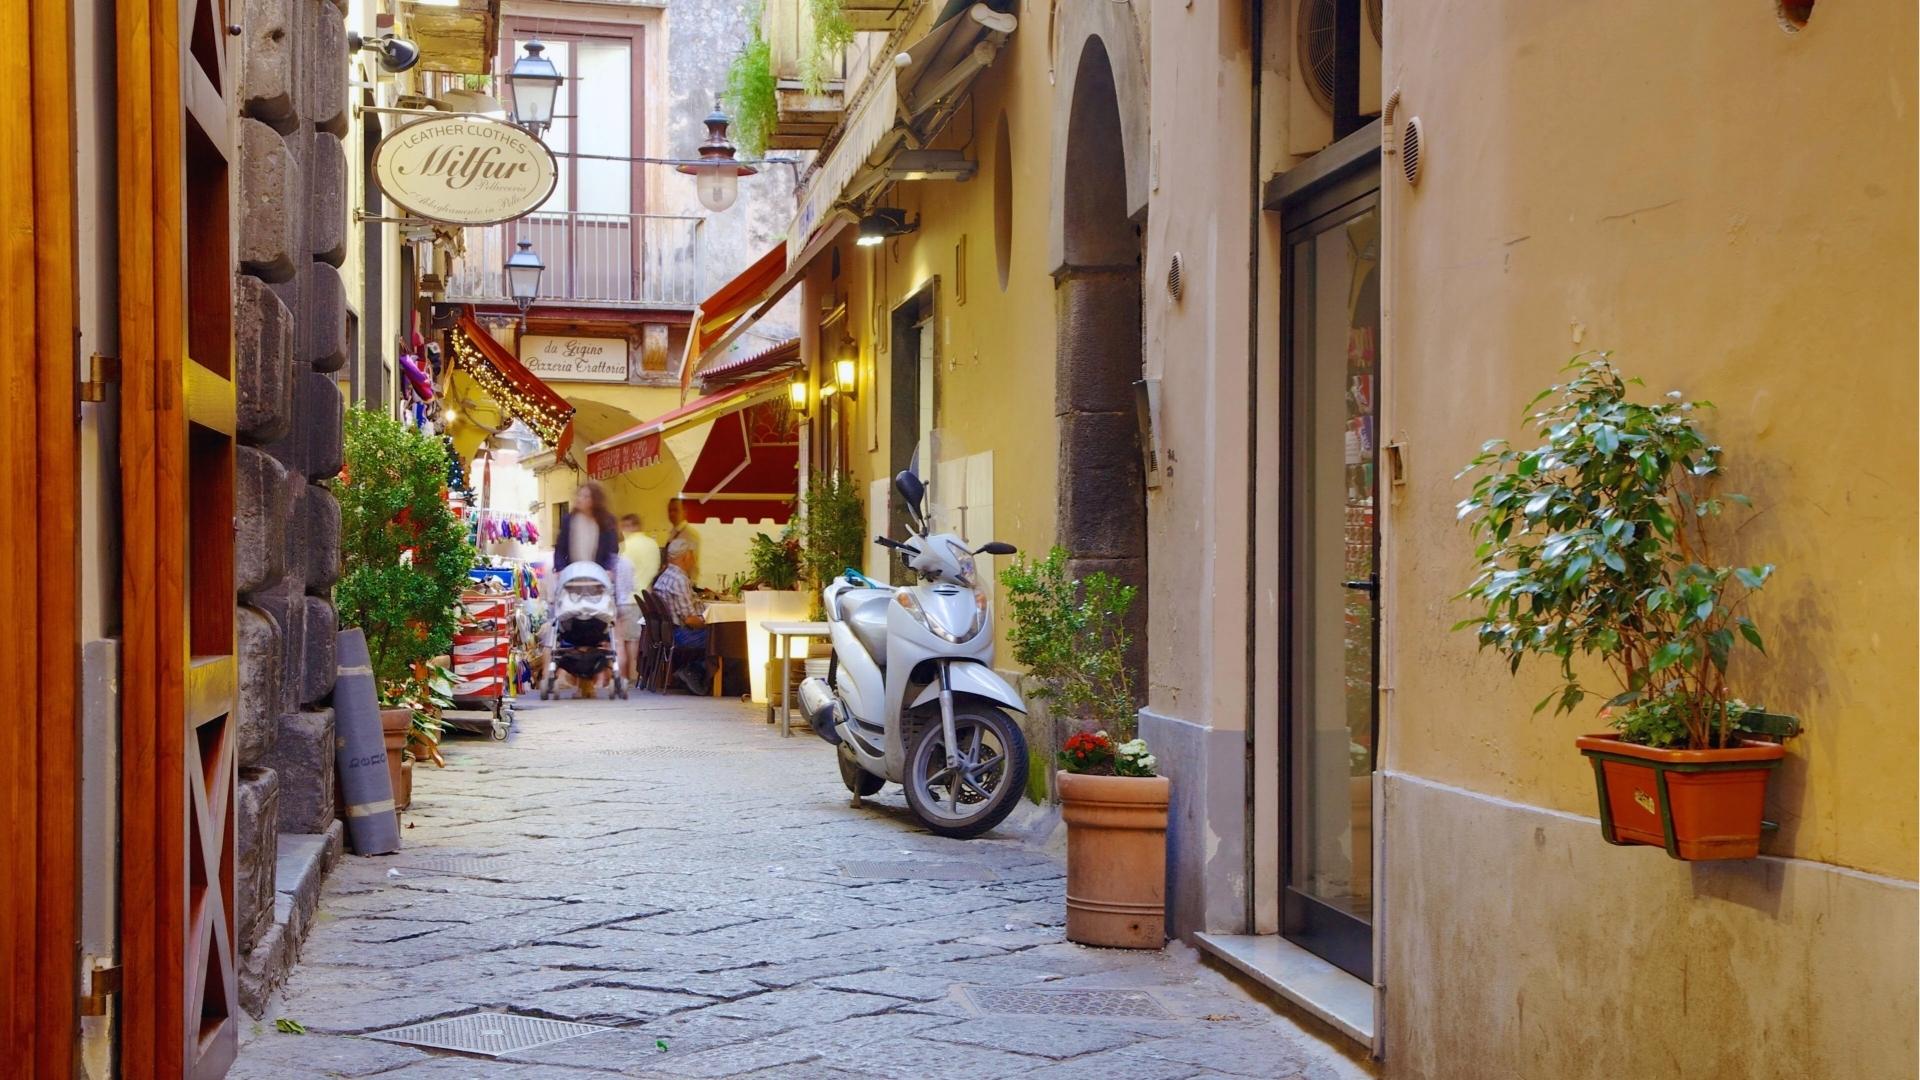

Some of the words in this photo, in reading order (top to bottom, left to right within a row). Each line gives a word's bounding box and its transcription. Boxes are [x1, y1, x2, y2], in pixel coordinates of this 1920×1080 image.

[403, 124, 464, 149] LEATHER
[467, 125, 527, 154] CLOTHES
[398, 144, 529, 190] Milfur
[544, 340, 558, 354] da
[562, 340, 603, 357] Gigino
[525, 356, 572, 373] Pizzeria
[575, 357, 626, 374] Trattoria
